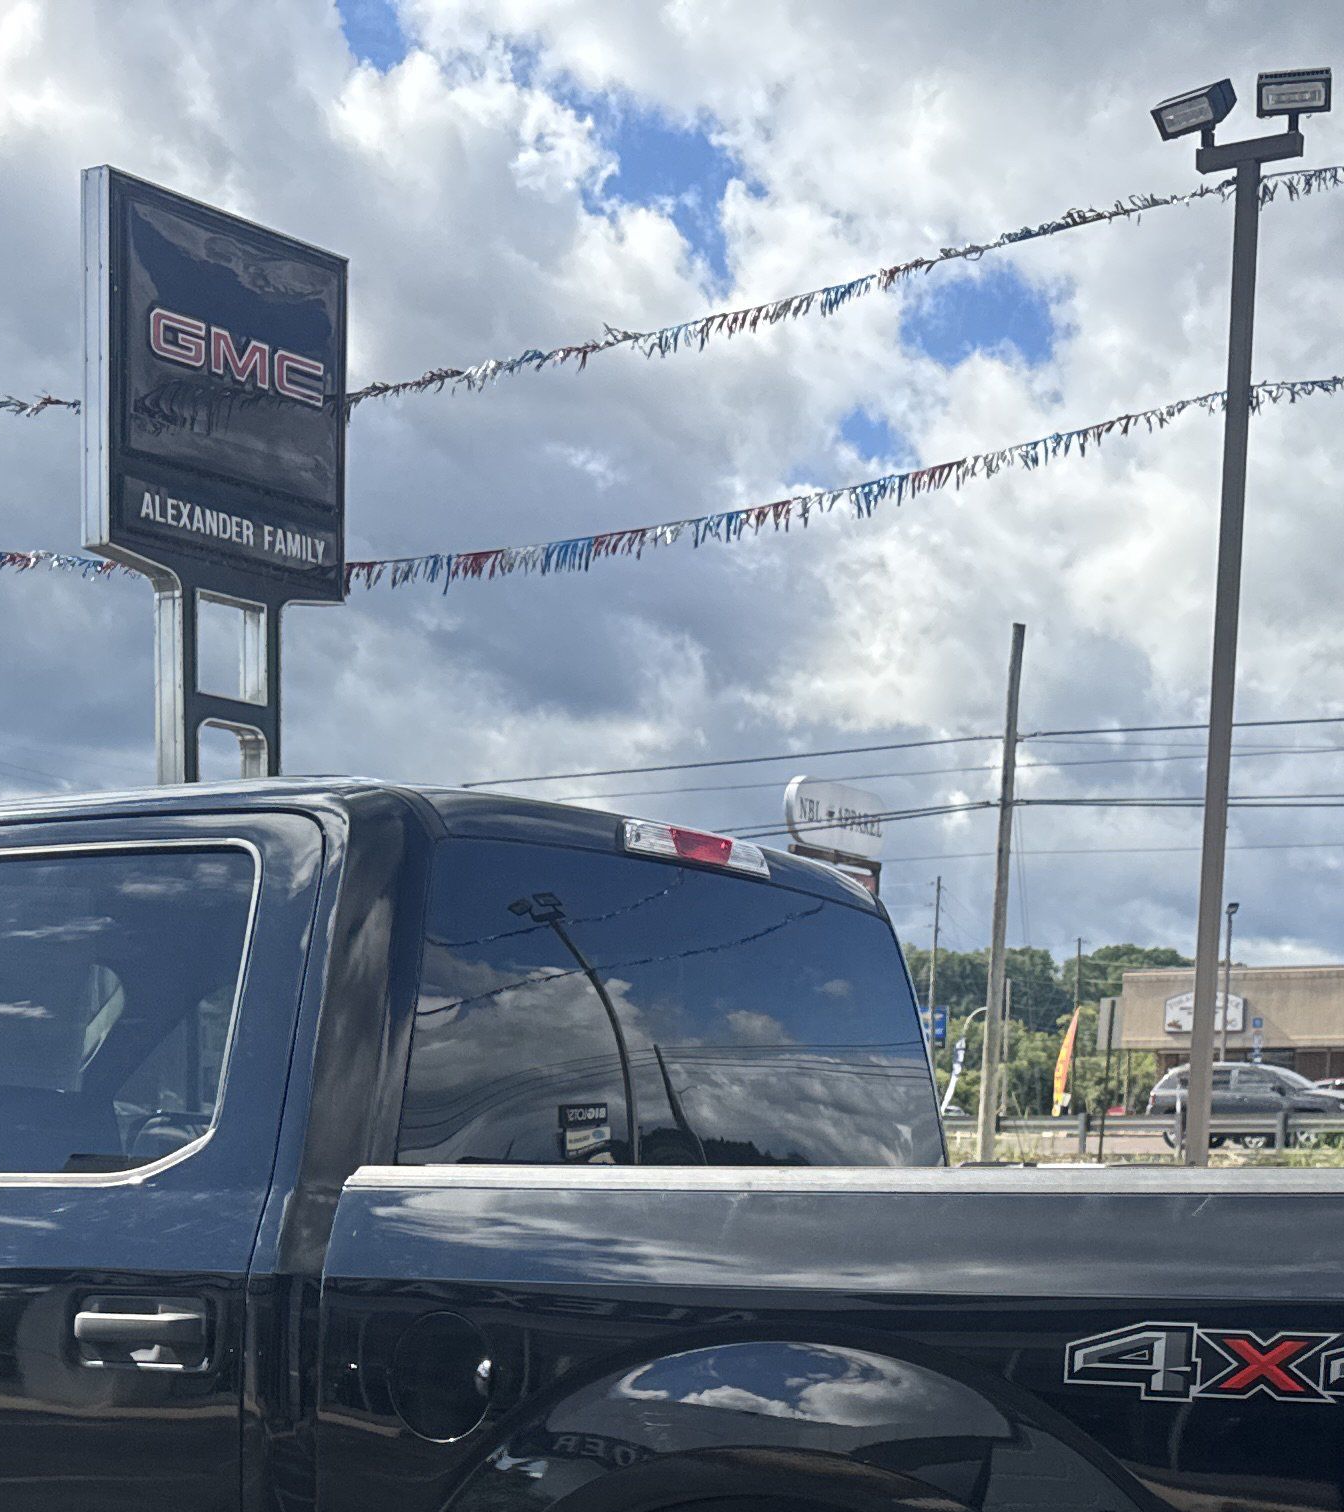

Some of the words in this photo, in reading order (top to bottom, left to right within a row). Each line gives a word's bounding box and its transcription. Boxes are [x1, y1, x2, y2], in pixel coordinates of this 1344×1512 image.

[150, 308, 324, 407] GMC
[140, 491, 254, 546] ALEXANDER
[263, 526, 326, 565] FAMILY
